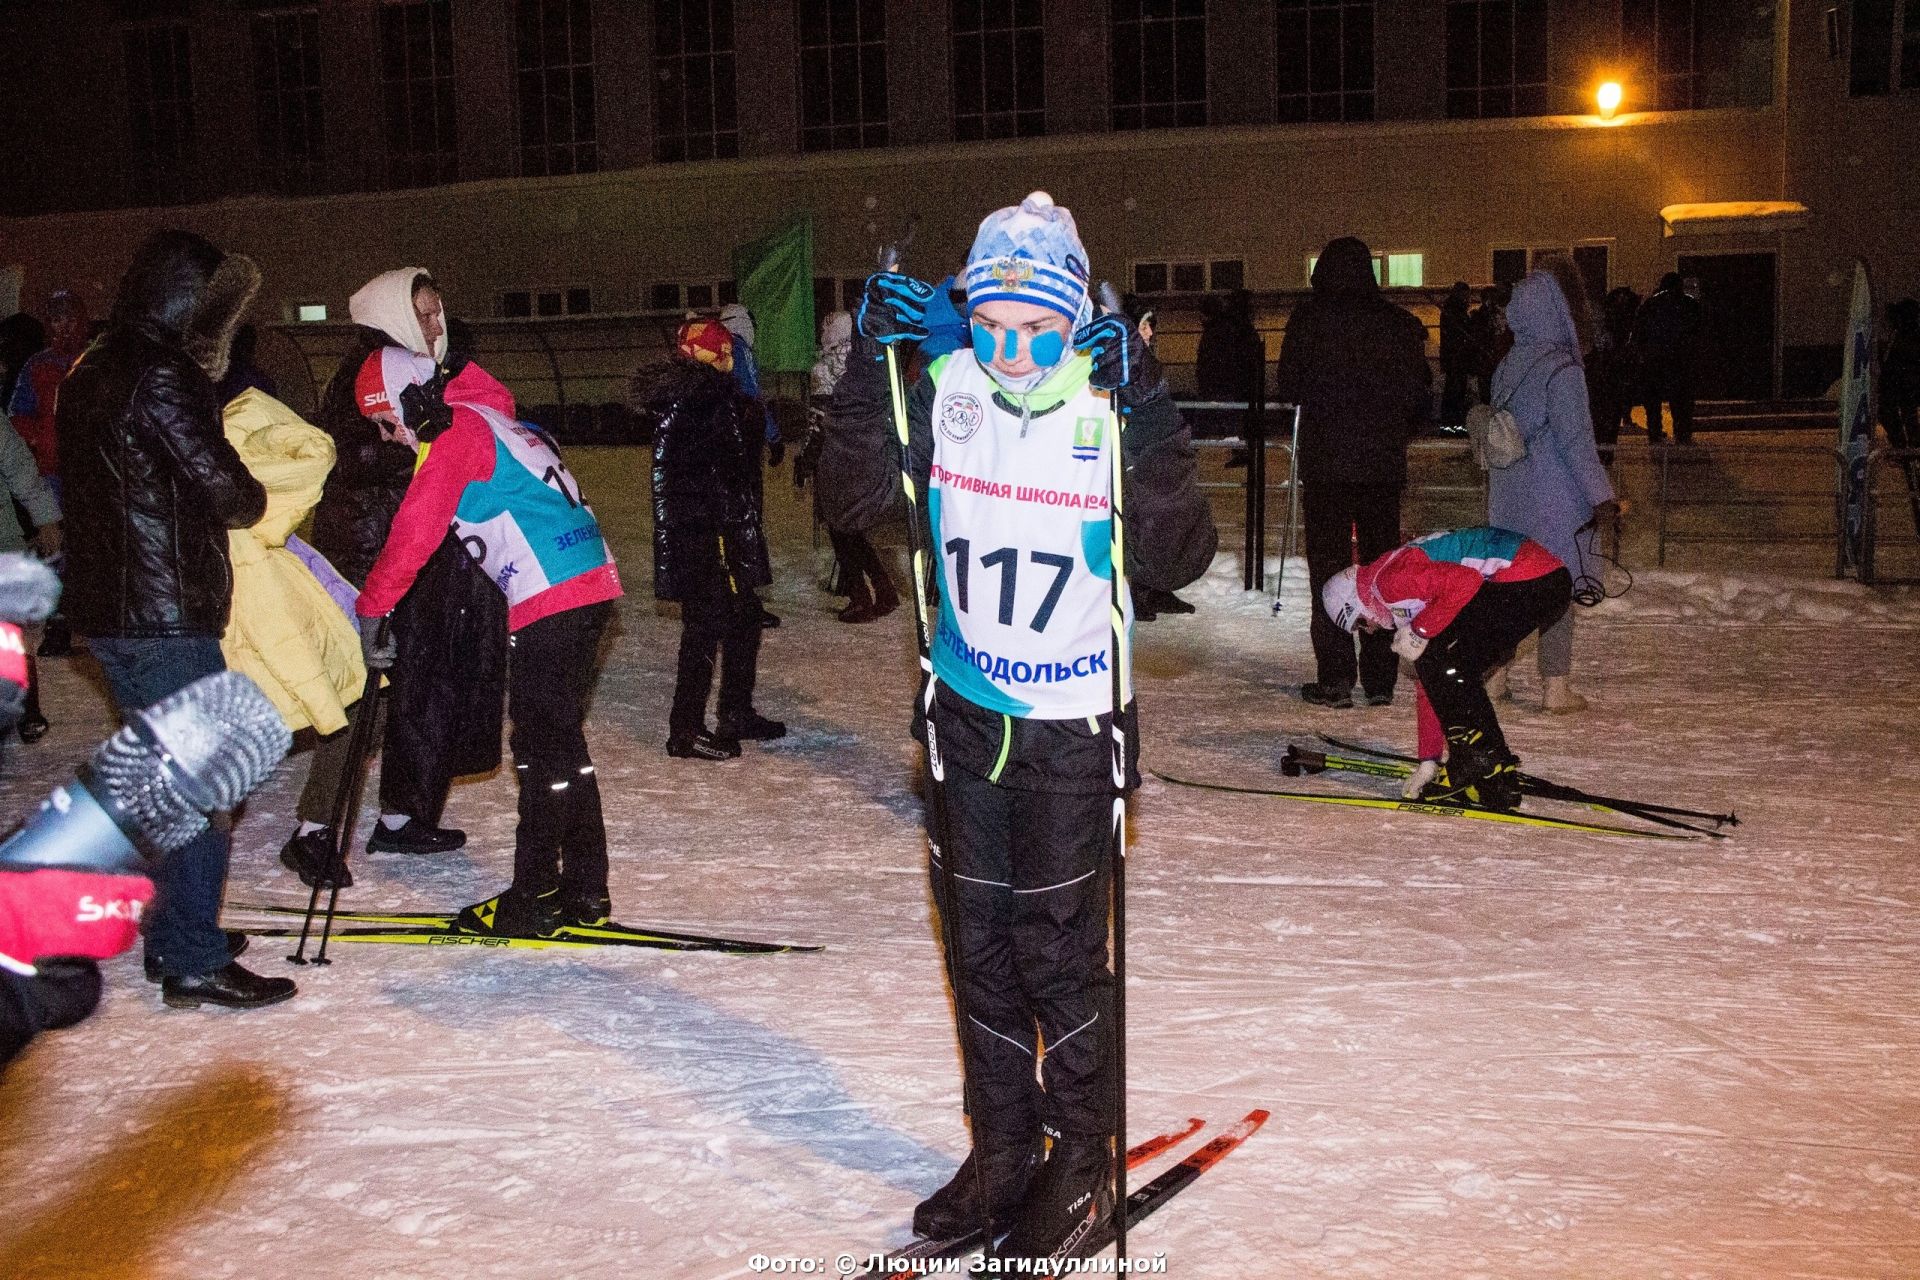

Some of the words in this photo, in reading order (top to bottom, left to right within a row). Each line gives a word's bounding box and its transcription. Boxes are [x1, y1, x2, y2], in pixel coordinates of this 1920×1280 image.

[1016, 486, 1082, 508] ШКОЛА
[945, 536, 1074, 634] 117
[927, 722, 938, 771] SPORT
[1396, 803, 1465, 817] FISCHER
[428, 935, 511, 947] FISCHER
[1067, 1191, 1092, 1214] TISA
